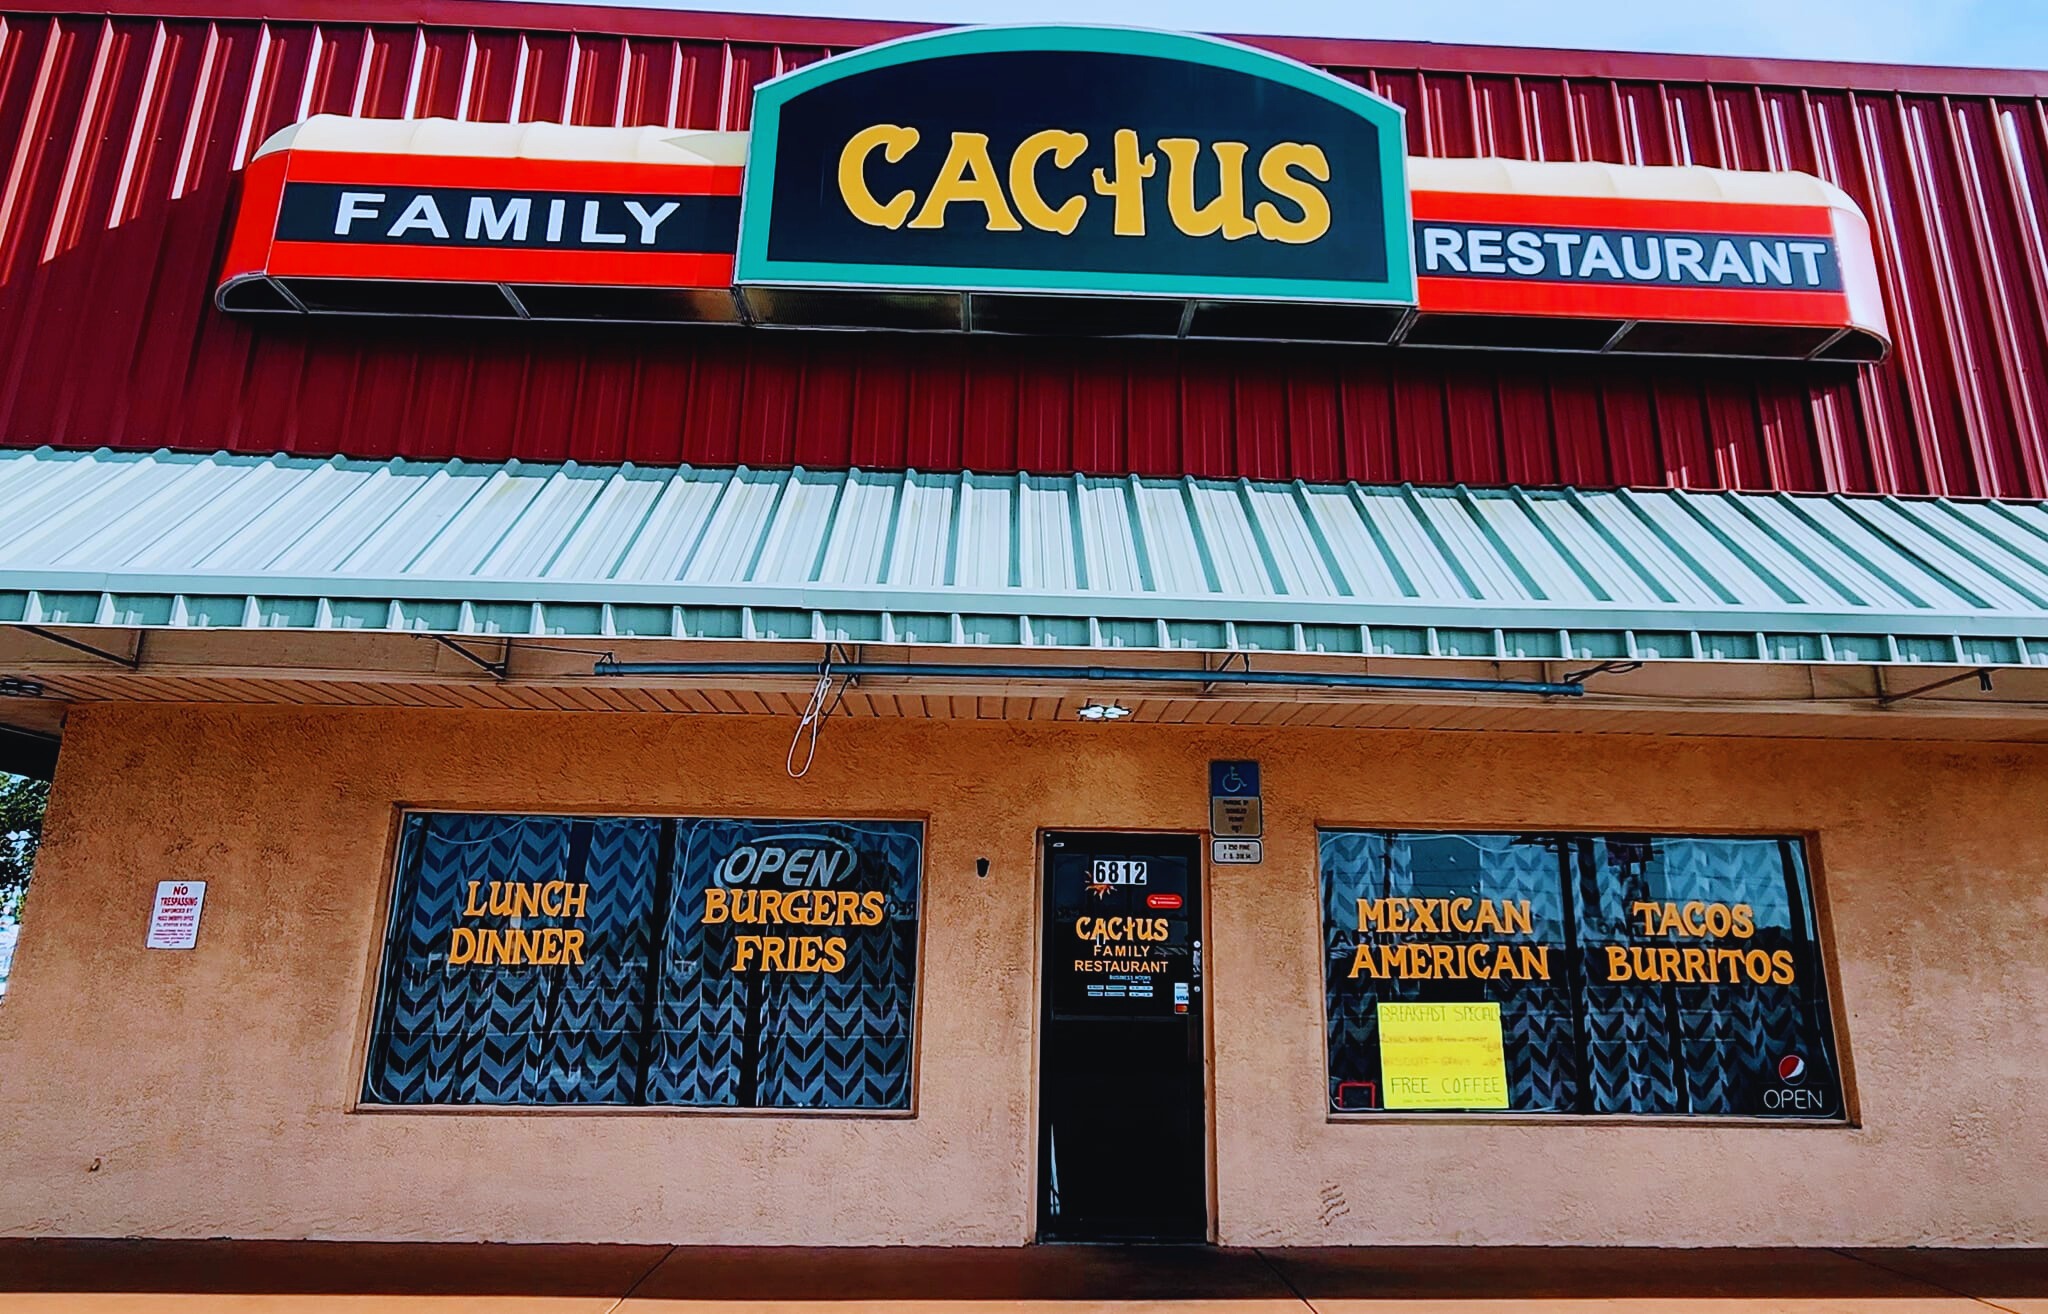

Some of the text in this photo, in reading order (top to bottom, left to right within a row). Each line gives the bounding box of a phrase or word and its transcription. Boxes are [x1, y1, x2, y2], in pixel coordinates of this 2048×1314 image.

[837, 124, 1332, 246] CACTUS
[334, 192, 680, 245] FAMILY
[1422, 225, 1827, 289] RESTAURANT
[723, 846, 843, 887] OPEN
[1095, 861, 1146, 884] 6812
[173, 886, 188, 895] NO
[463, 880, 588, 918] LUNCH
[701, 888, 884, 926] BURGERS
[1075, 916, 1168, 941] CACTUS
[1356, 897, 1533, 934] MEXICAN
[1633, 901, 1754, 938] TACOS
[449, 927, 585, 966] DINNER
[732, 935, 848, 973] FRIES
[1093, 945, 1150, 957] FAMILY
[1347, 943, 1550, 980] AMERICAN
[1606, 946, 1796, 984] BURRITOS
[1074, 960, 1168, 973] RESTAURANT
[1382, 1006, 1446, 1022] BREAKFAST
[1391, 1076, 1501, 1095] FREE COFFEE
[1763, 1089, 1823, 1109] OPEN
